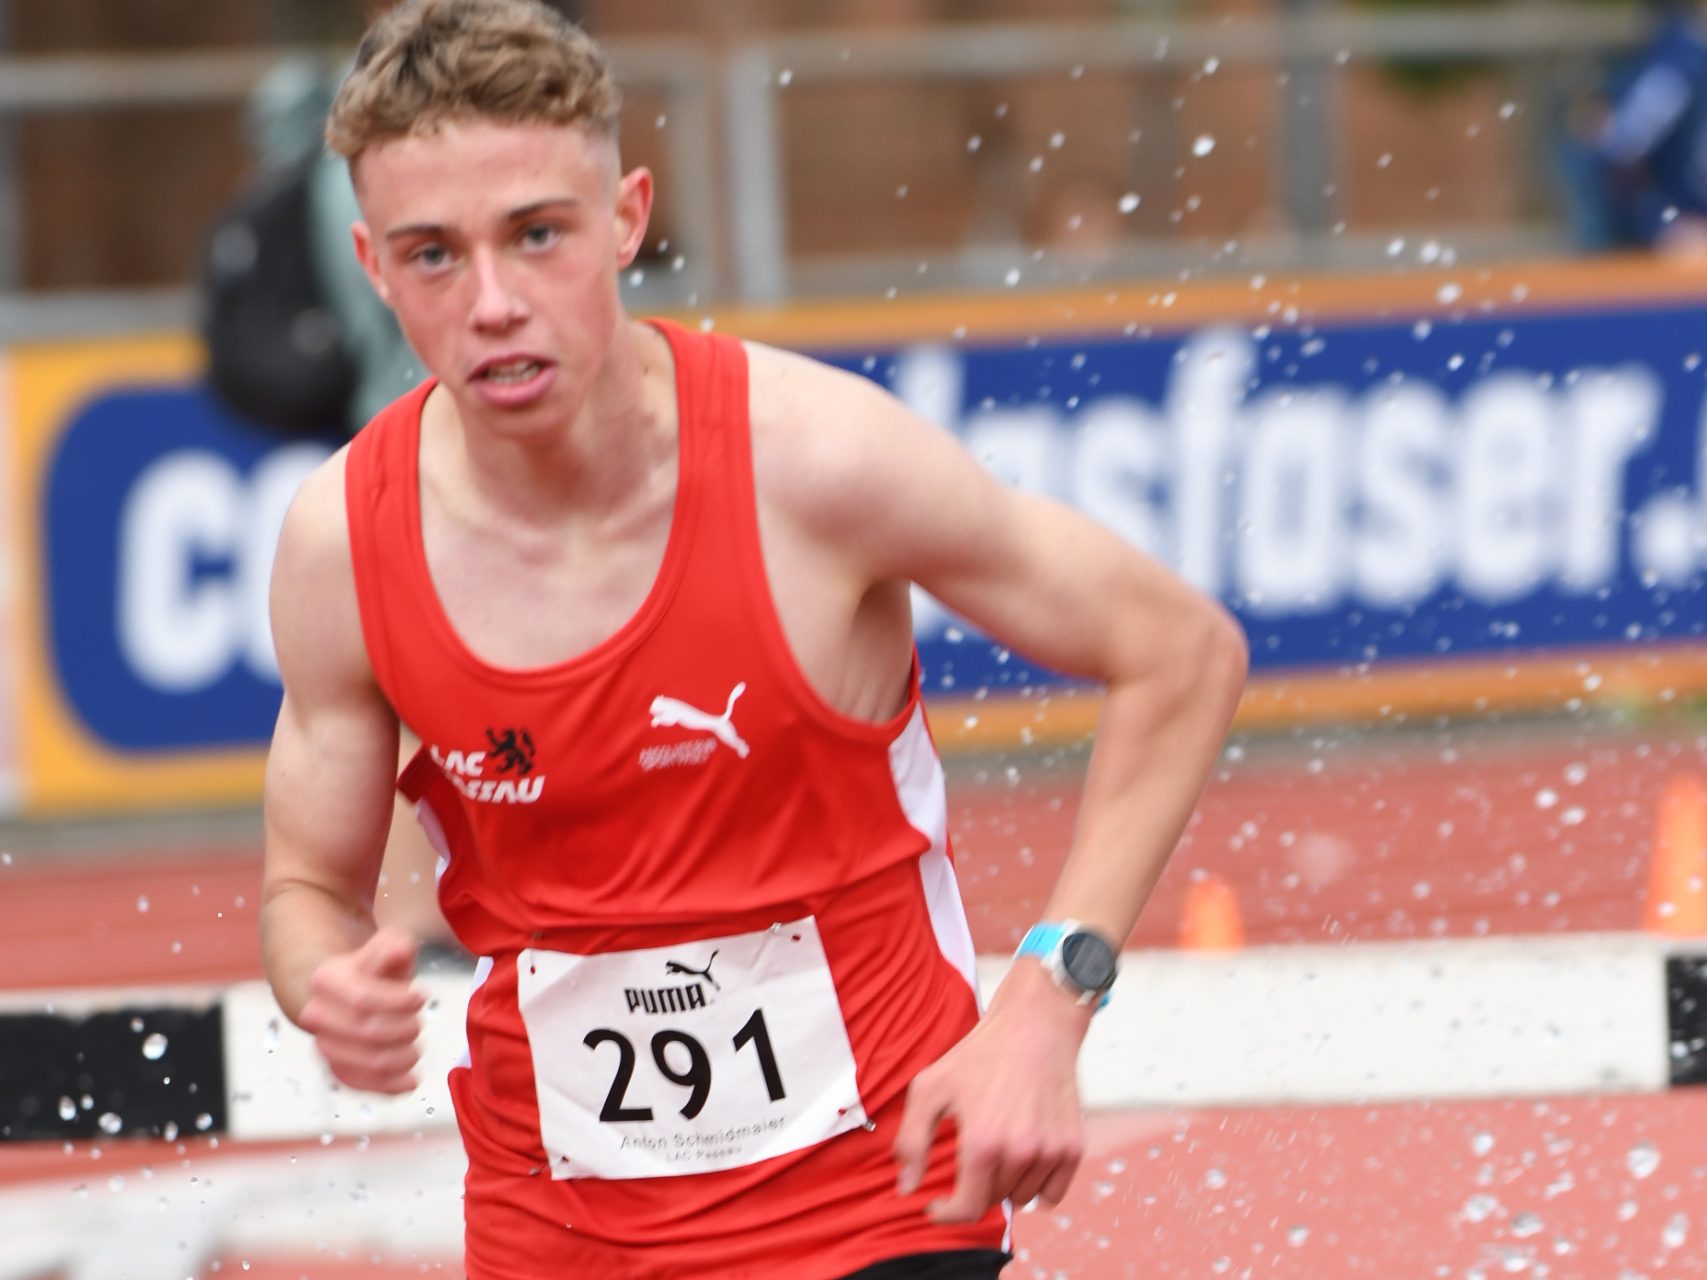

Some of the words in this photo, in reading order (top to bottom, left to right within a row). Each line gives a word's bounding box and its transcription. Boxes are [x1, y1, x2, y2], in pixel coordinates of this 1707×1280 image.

[430, 745, 486, 777] LAC
[624, 983, 707, 1014] PUMA
[582, 1008, 787, 1123] 291
[620, 1134, 668, 1151] Anton
[673, 1116, 786, 1148] Schmidmaier
